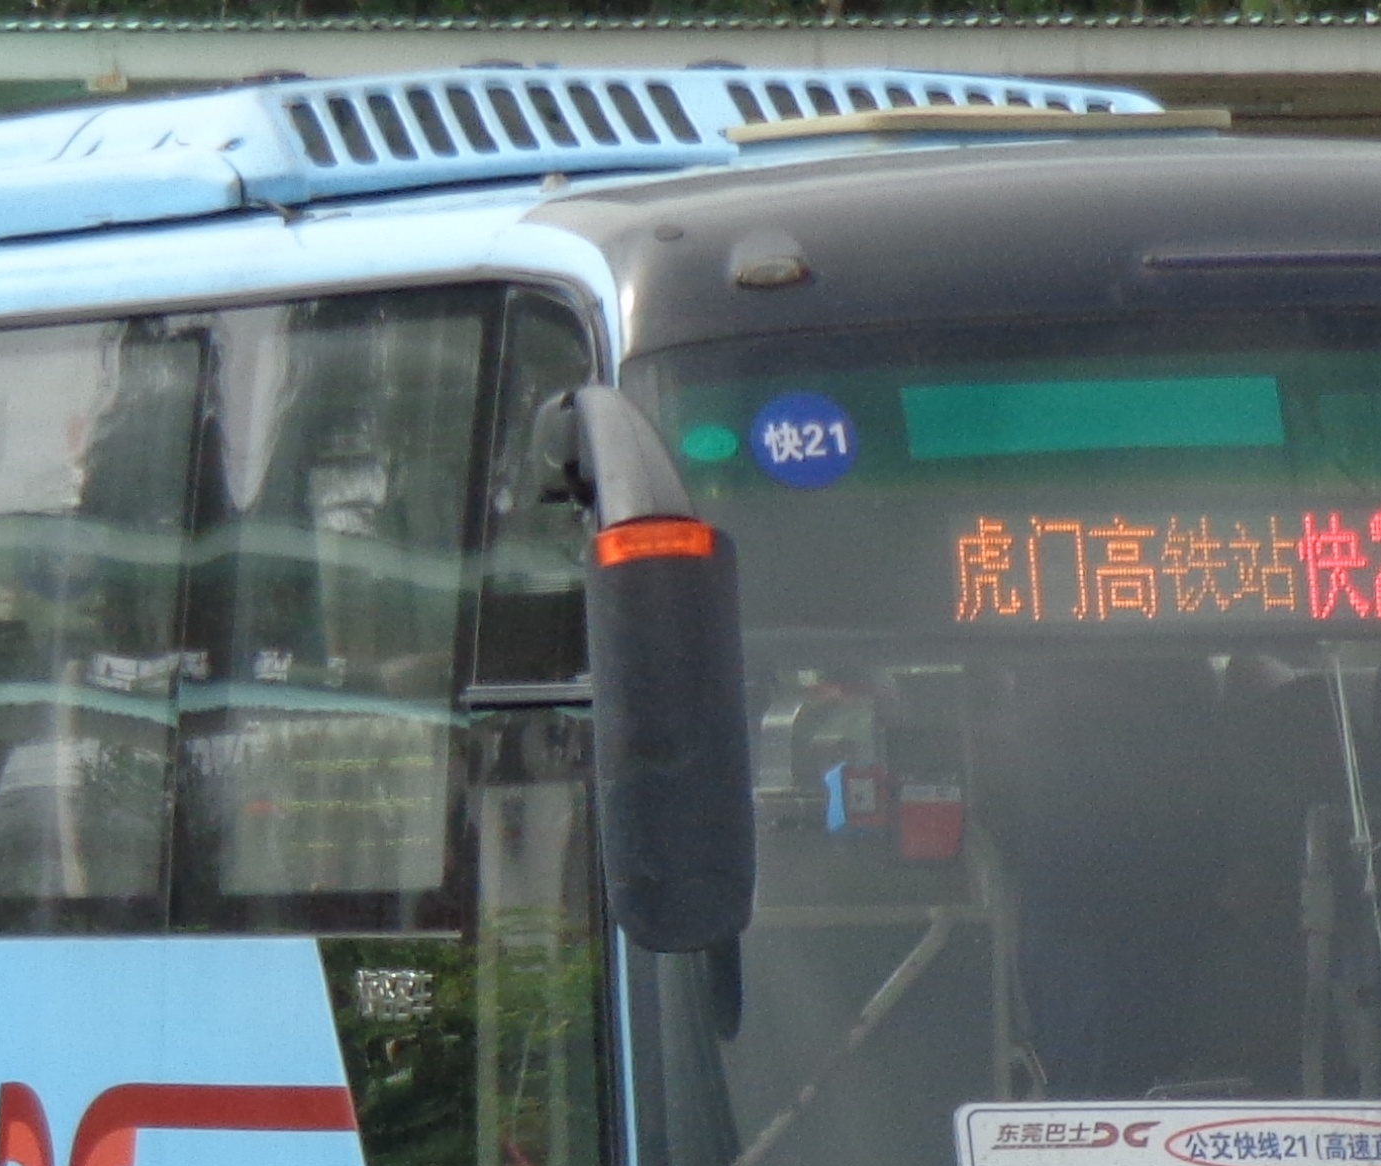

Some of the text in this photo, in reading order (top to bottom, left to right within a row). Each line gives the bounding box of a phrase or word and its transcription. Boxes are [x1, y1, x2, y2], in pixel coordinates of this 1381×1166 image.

[764, 421, 848, 463] 快21
[955, 515, 1296, 622] 虎门高铁站
[996, 1121, 1093, 1144] 东莞巴士
